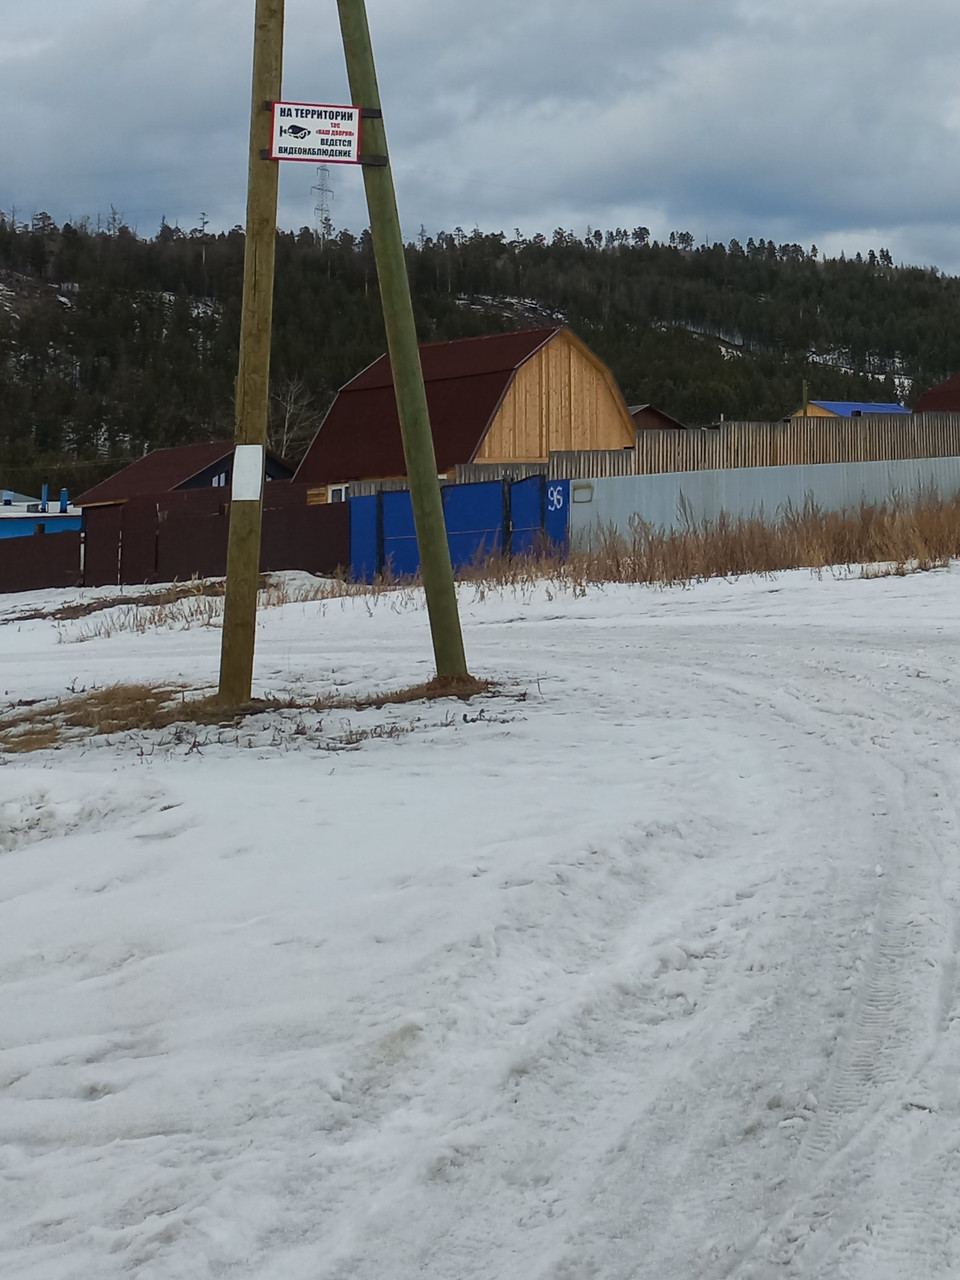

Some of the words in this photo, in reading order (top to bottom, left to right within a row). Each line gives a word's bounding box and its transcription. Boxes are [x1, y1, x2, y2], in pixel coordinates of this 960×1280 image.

[280, 107, 292, 118] НА
[294, 108, 353, 121] ТЕРРИТОРИИ
[320, 138, 352, 147] ВЕДЕТСЯ
[278, 146, 352, 157] ВИДЕОНАБЛЮДЕНИЕ
[548, 486, 563, 511] 96
